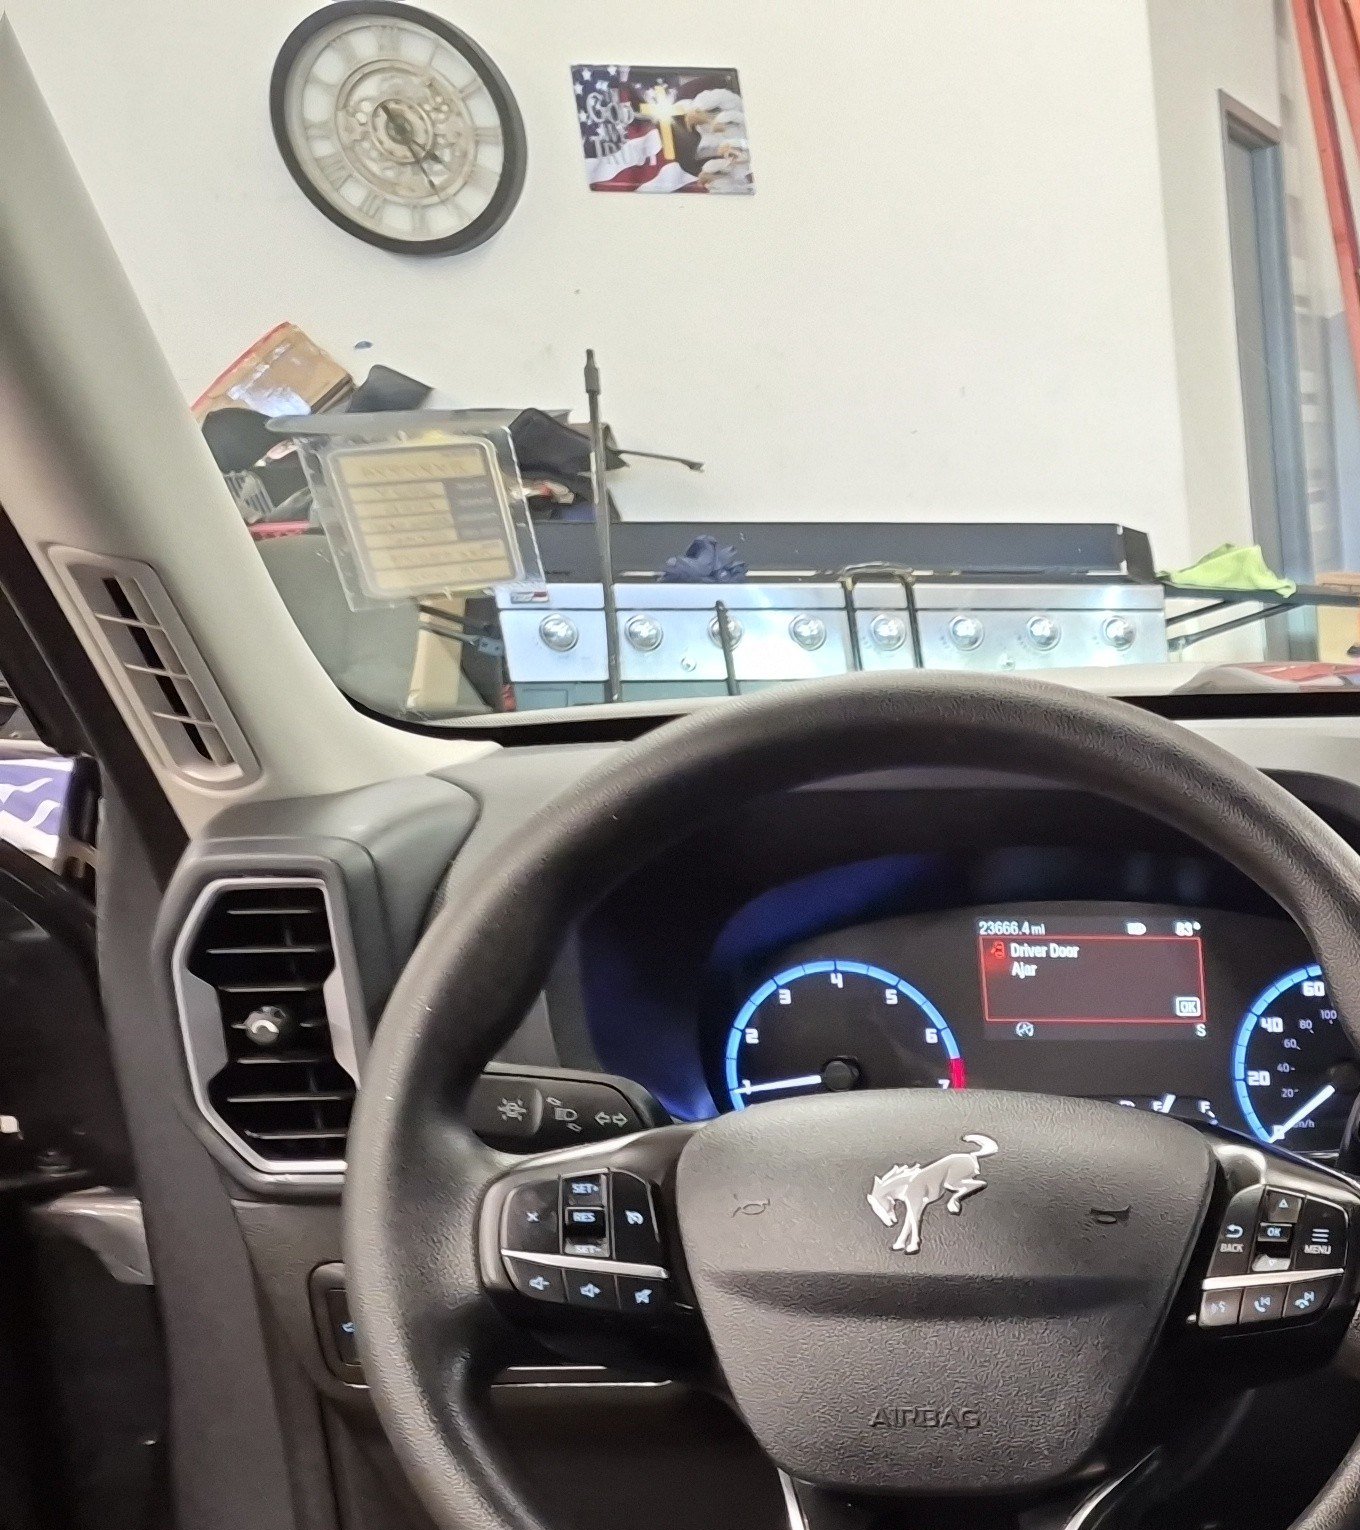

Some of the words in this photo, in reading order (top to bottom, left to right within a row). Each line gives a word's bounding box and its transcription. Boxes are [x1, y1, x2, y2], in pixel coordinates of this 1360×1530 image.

[979, 922, 1029, 935] 23666.4
[1010, 943, 1047, 958] Driver
[1050, 943, 1079, 958] Door
[1011, 962, 1037, 978] Ajar
[830, 973, 844, 988] 4
[1302, 982, 1325, 996] 60
[779, 989, 791, 1004] 3
[885, 989, 898, 1004] 5
[1180, 1001, 1196, 1013] OK
[1320, 1010, 1337, 1019] 100
[1260, 1018, 1283, 1032] 40
[1299, 1020, 1312, 1029] 80
[745, 1029, 759, 1044] 2
[925, 1028, 938, 1043] 6
[1284, 1039, 1297, 1048] 60
[1277, 1063, 1289, 1072] 40
[1248, 1071, 1270, 1086] 20
[1281, 1088, 1293, 1098] 20
[1267, 1228, 1281, 1236] OK
[1220, 1244, 1244, 1252] BACK
[1304, 1245, 1331, 1254] MENU
[868, 1406, 981, 1428] AIRBAG
